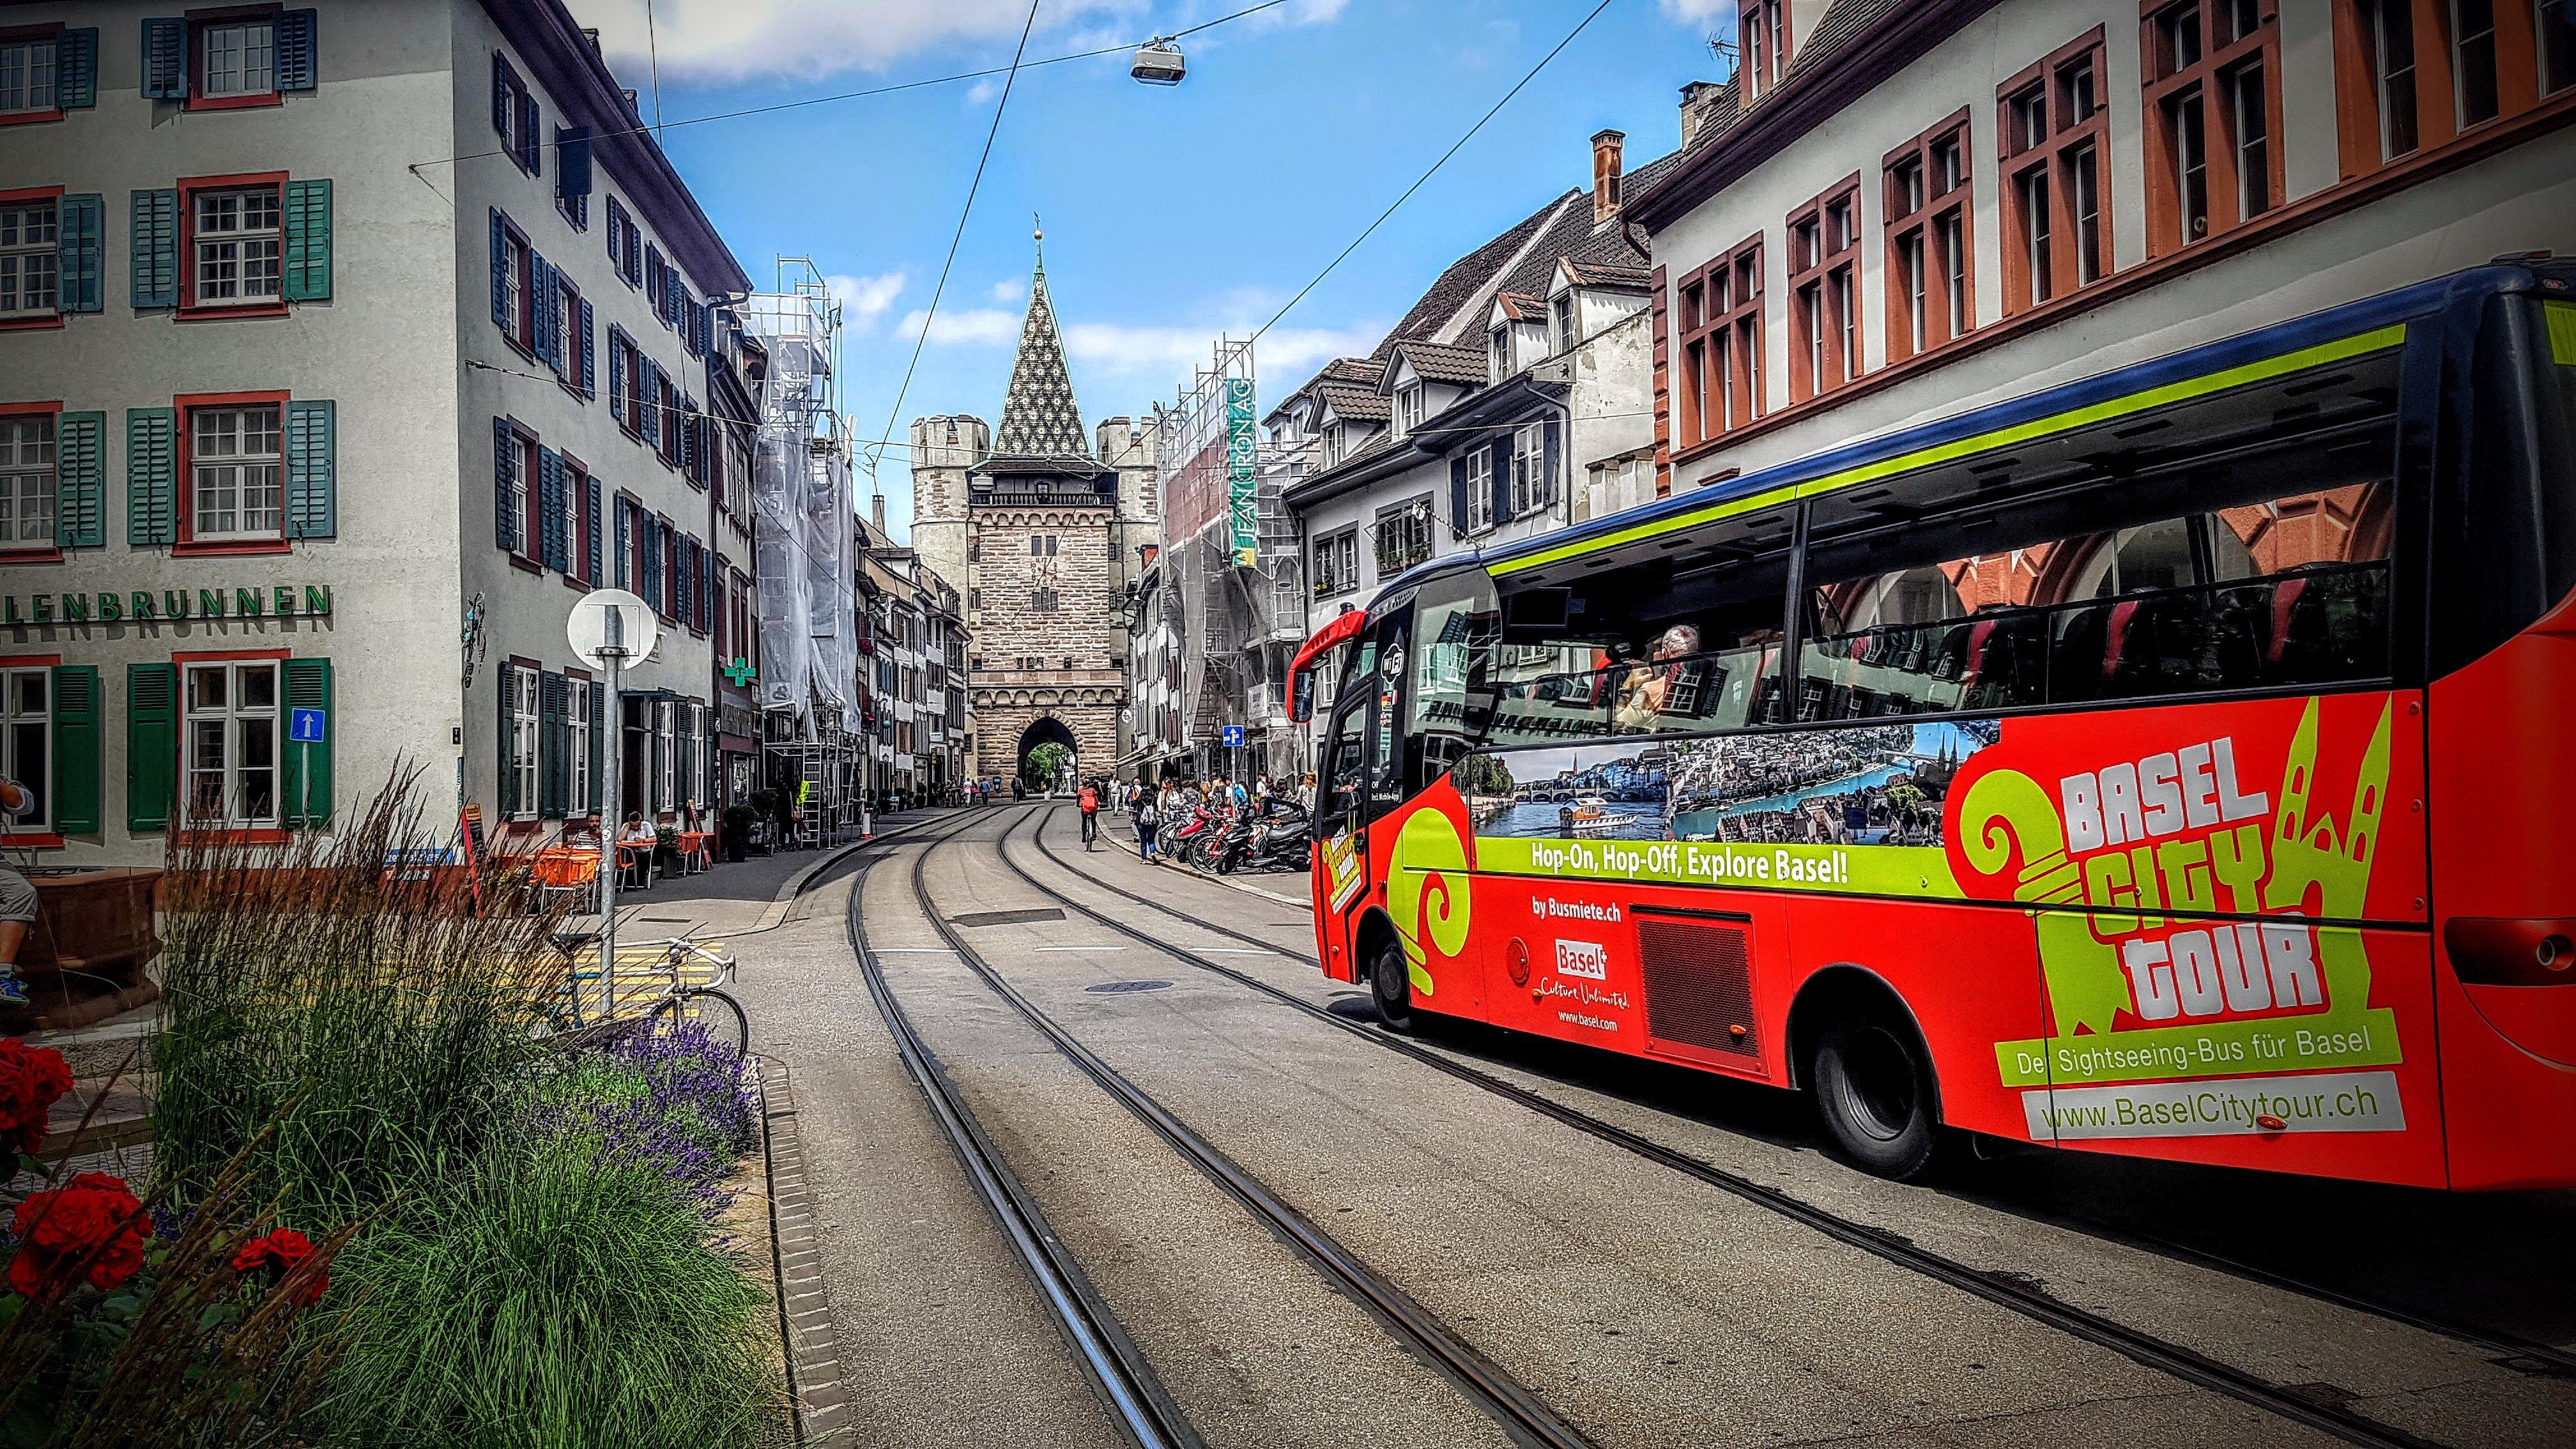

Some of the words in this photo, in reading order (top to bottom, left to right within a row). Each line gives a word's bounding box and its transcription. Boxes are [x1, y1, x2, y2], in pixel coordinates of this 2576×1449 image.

[1233, 379, 1254, 413] AG
[1234, 487, 1256, 542] JEAN
[4, 585, 330, 624] LENBRUNNEN
[2060, 736, 2270, 854] BASEL
[1531, 842, 1598, 875] Hop-On,
[1603, 844, 1682, 878] Hop-Off,
[1687, 847, 1769, 883] Explore
[1775, 850, 1848, 884] Basel!
[2085, 823, 2266, 937] CITY
[1532, 895, 1546, 919] by
[1548, 897, 1621, 923] Busmiete.ch
[1558, 944, 1602, 975] Basel
[2121, 911, 2324, 1022] TOUR
[1540, 976, 1579, 1000] Culture
[1579, 981, 1630, 1009] Unlimited.
[1558, 1010, 1618, 1032] www.basel.com
[2058, 1038, 2244, 1077] Sightseeing-Bus
[2251, 1033, 2287, 1059] für
[2295, 1025, 2372, 1056] Basel
[2041, 1084, 2379, 1129] www.BaselCitytour.ch
